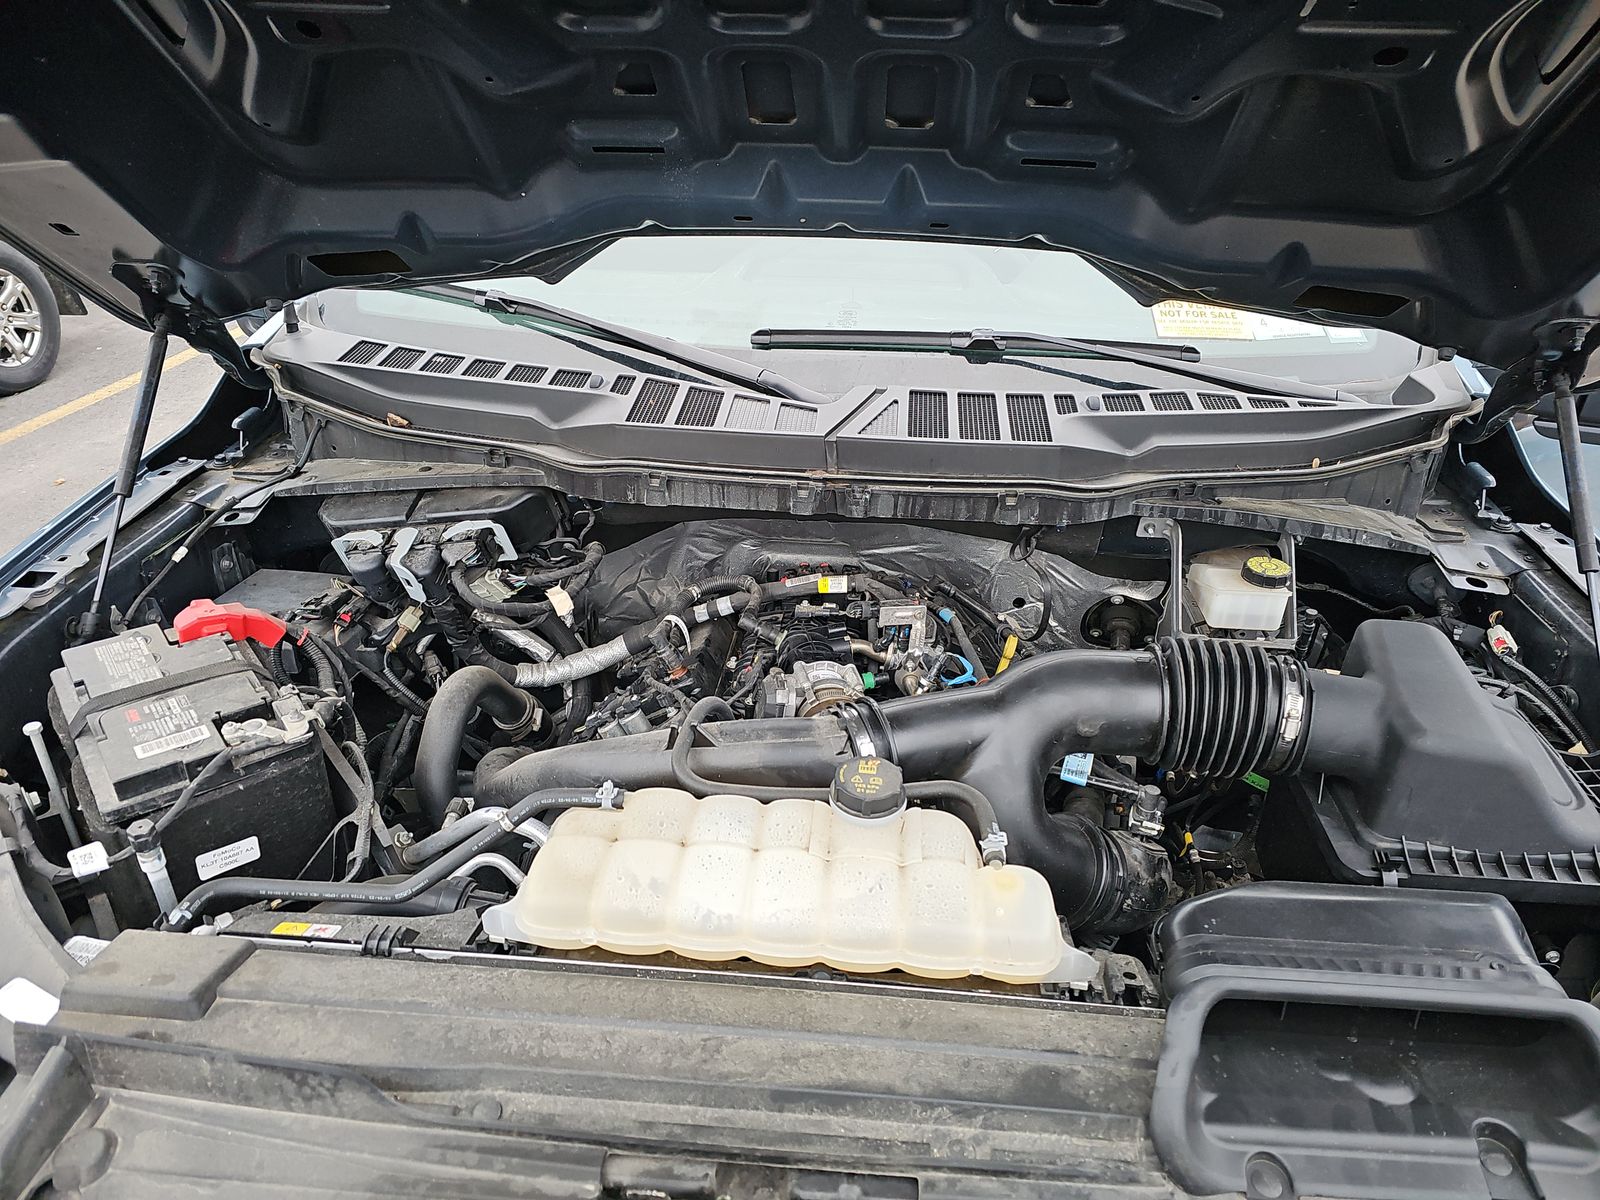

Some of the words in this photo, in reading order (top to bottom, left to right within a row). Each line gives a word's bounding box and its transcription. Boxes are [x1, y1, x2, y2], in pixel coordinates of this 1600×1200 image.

[1160, 310, 1181, 318] NOT
[1185, 311, 1207, 319] FOR
[1210, 311, 1238, 320] SALE
